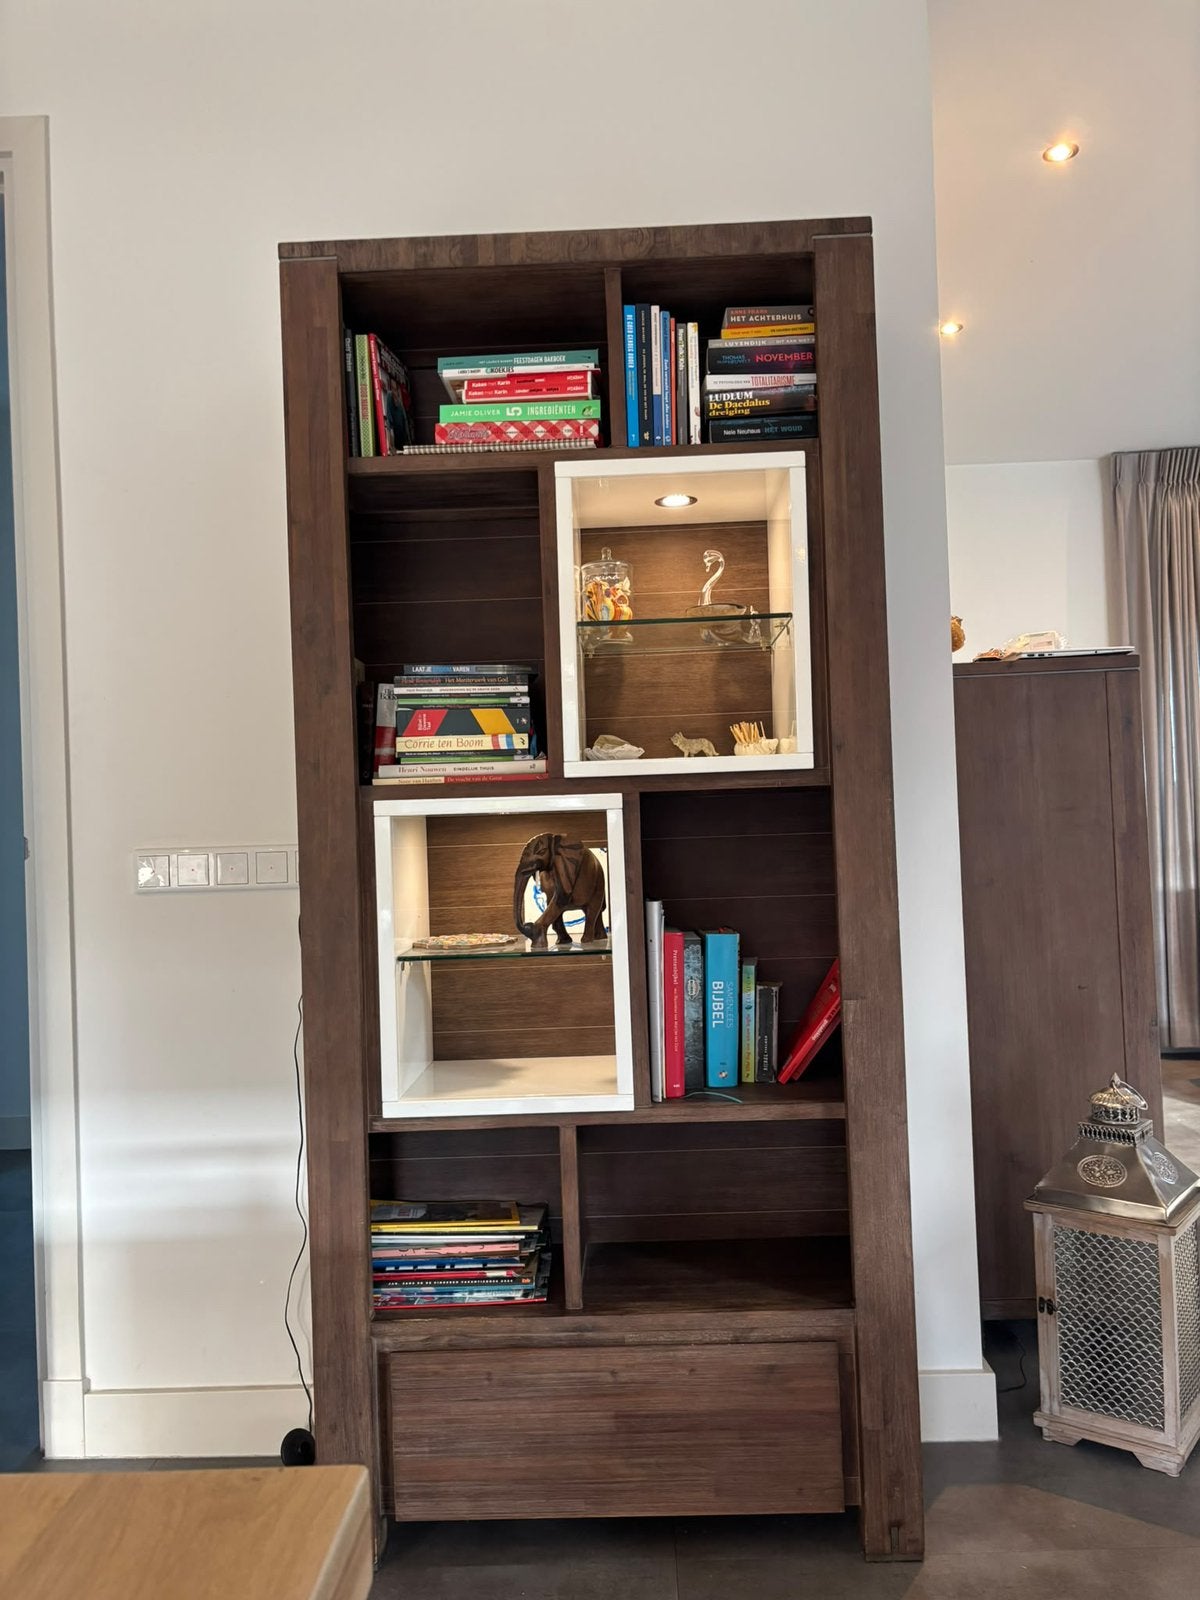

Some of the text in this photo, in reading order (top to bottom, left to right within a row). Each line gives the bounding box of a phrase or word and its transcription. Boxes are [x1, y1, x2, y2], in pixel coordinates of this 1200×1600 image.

[513, 356, 543, 364] FEESTDAGEN
[544, 355, 566, 363] BAKBOEK
[755, 352, 813, 362] NOVEMBER
[751, 376, 795, 386] TOTALITARISME
[709, 391, 753, 401] LUDLUM
[724, 399, 770, 408] Daedalus
[527, 405, 576, 416] INGREDIËNTEN
[405, 737, 484, 749] Corrie ten Boom
[712, 981, 724, 1028] BIJBEL
